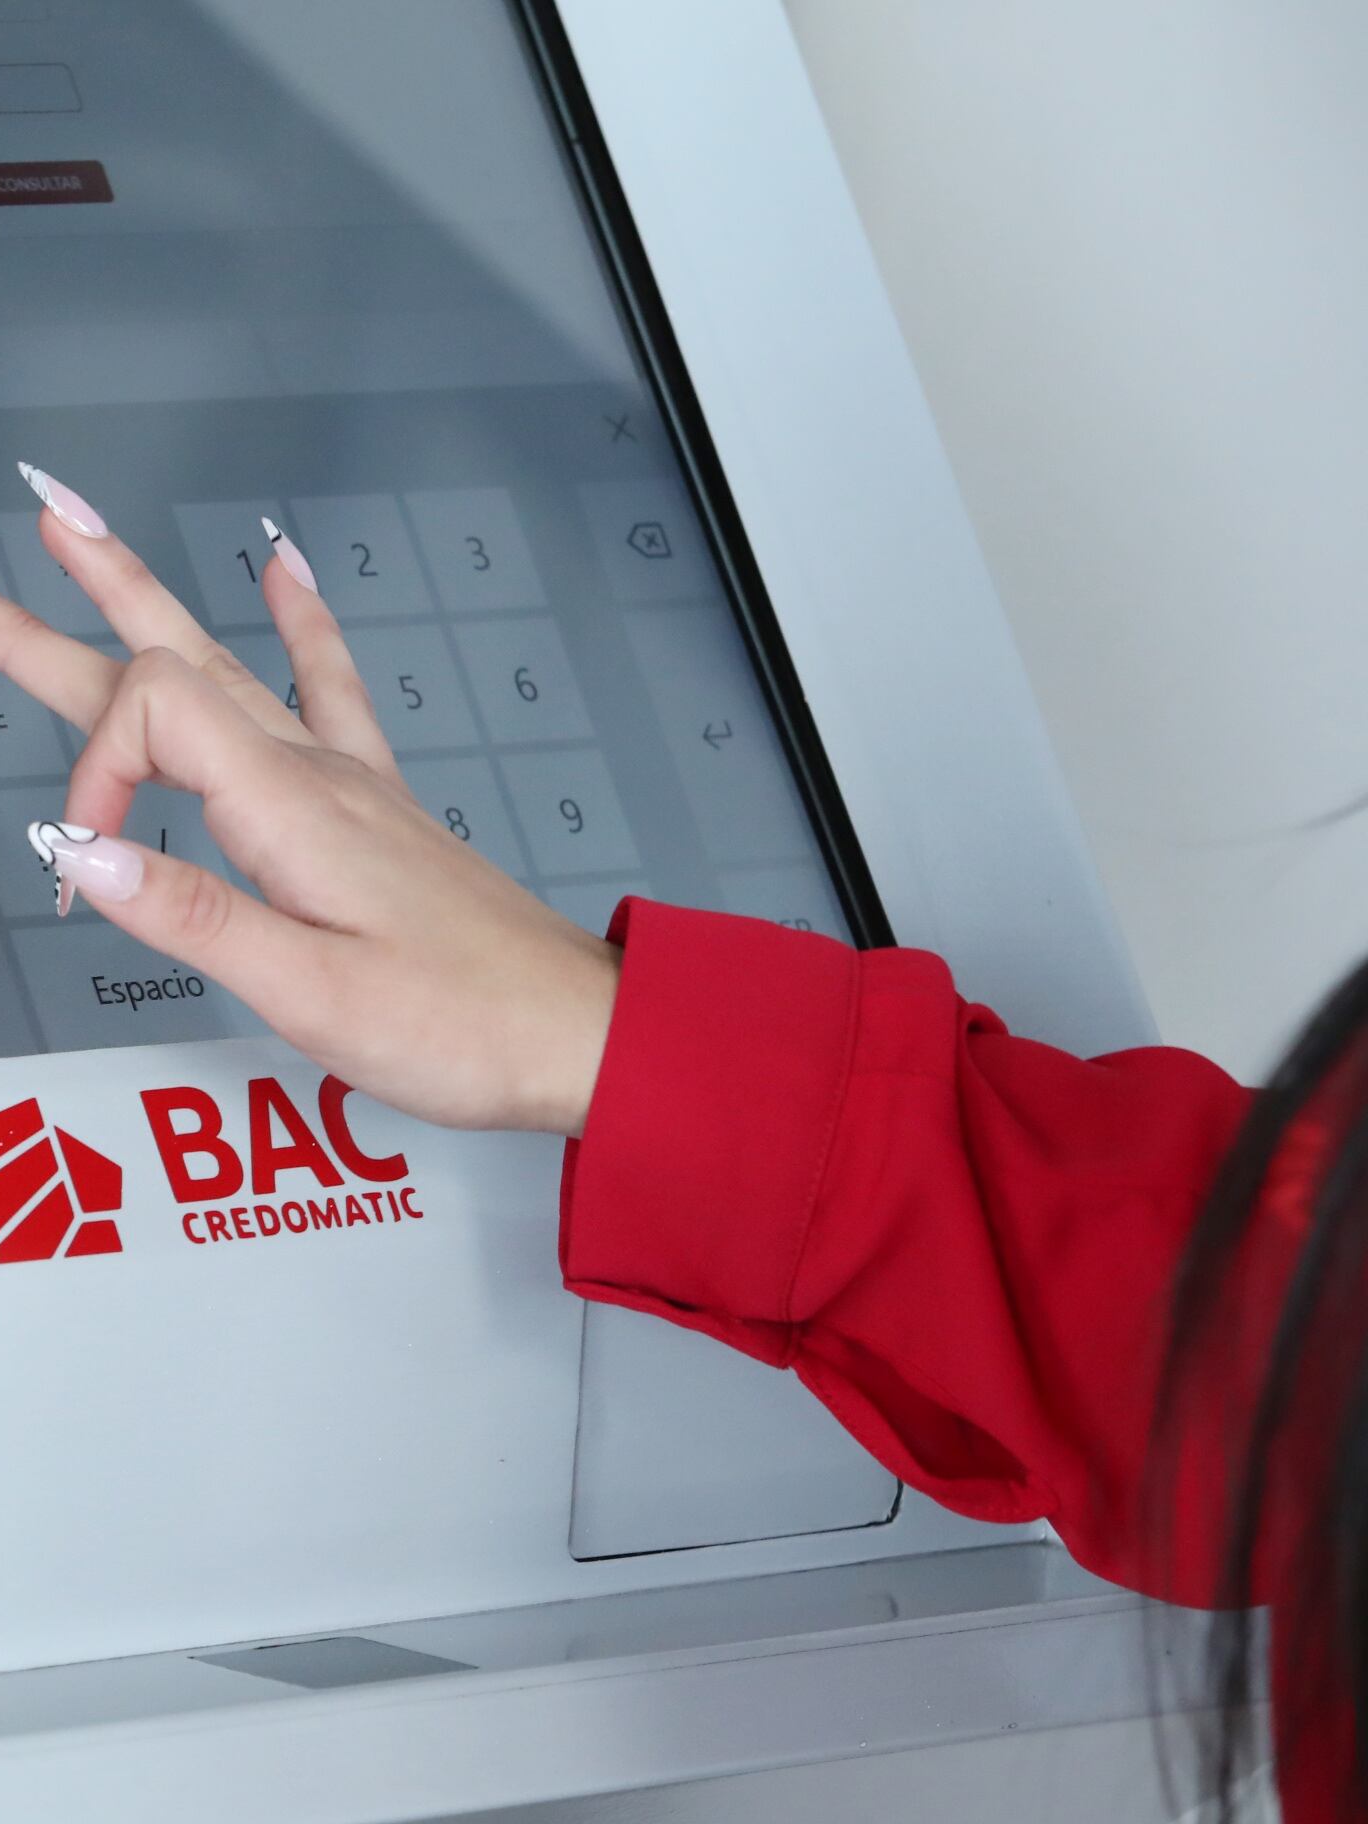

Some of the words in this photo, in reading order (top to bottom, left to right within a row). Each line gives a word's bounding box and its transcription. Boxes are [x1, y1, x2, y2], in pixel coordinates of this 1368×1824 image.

[236, 549, 256, 582] 1
[350, 543, 378, 577] 2
[465, 535, 491, 571] 3
[397, 675, 423, 711] 5
[514, 666, 539, 702] 6
[445, 807, 470, 841] 8
[558, 798, 584, 834] 9
[90, 968, 205, 1012] Espacio
[140, 1073, 409, 1204] BAC
[182, 1187, 424, 1244] CREDOMATIC
